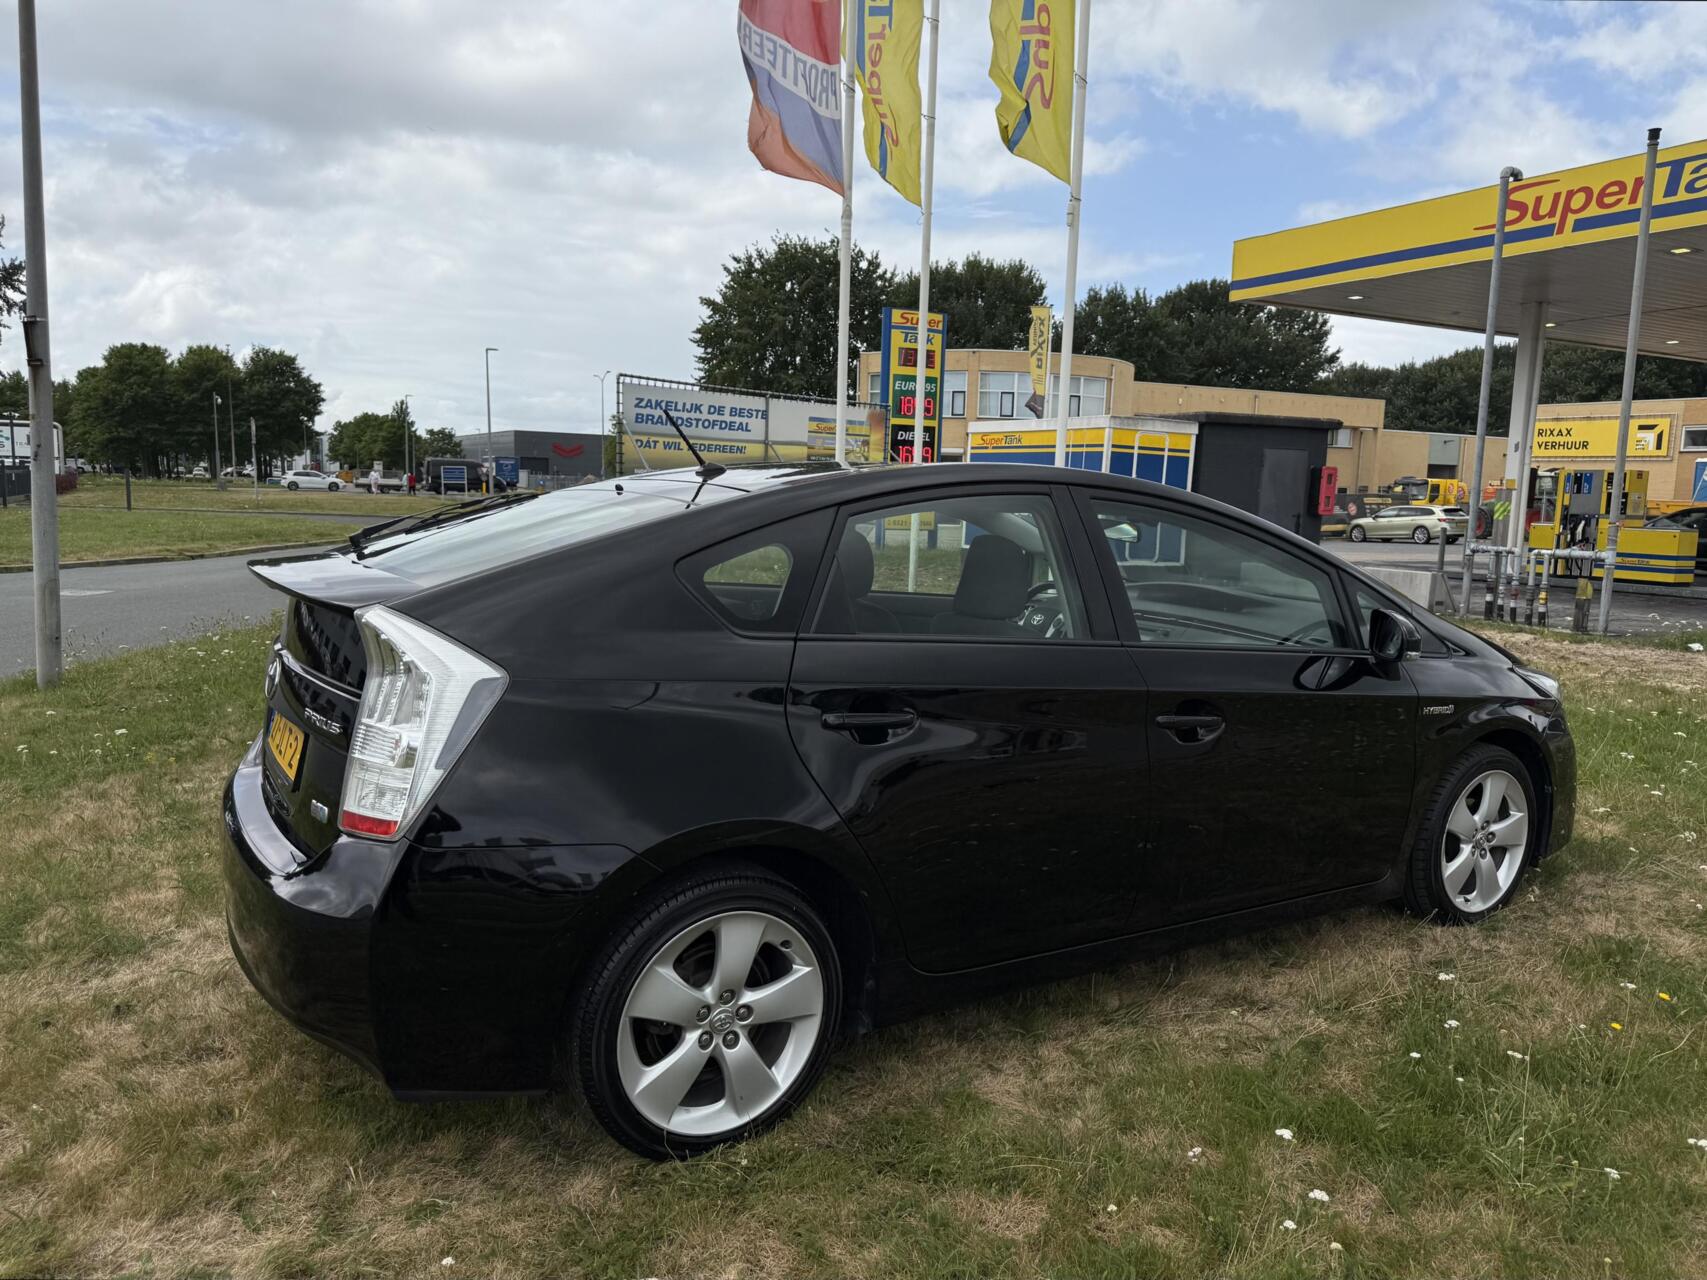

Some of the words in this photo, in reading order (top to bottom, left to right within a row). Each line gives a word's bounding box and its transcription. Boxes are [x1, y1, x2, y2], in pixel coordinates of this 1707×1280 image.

[892, 311, 942, 328] Suer
[901, 331, 935, 345] Tak
[634, 397, 703, 414] ZAKELIJK
[707, 404, 726, 416] DE
[729, 406, 768, 420] BESTE
[897, 431, 930, 441] DIEEL
[1537, 428, 1572, 437] RIXAX
[663, 440, 683, 451] WIL
[688, 442, 746, 454] EDEREEN!
[976, 434, 1022, 449] SuperTank
[1537, 441, 1589, 450] VERHUUR
